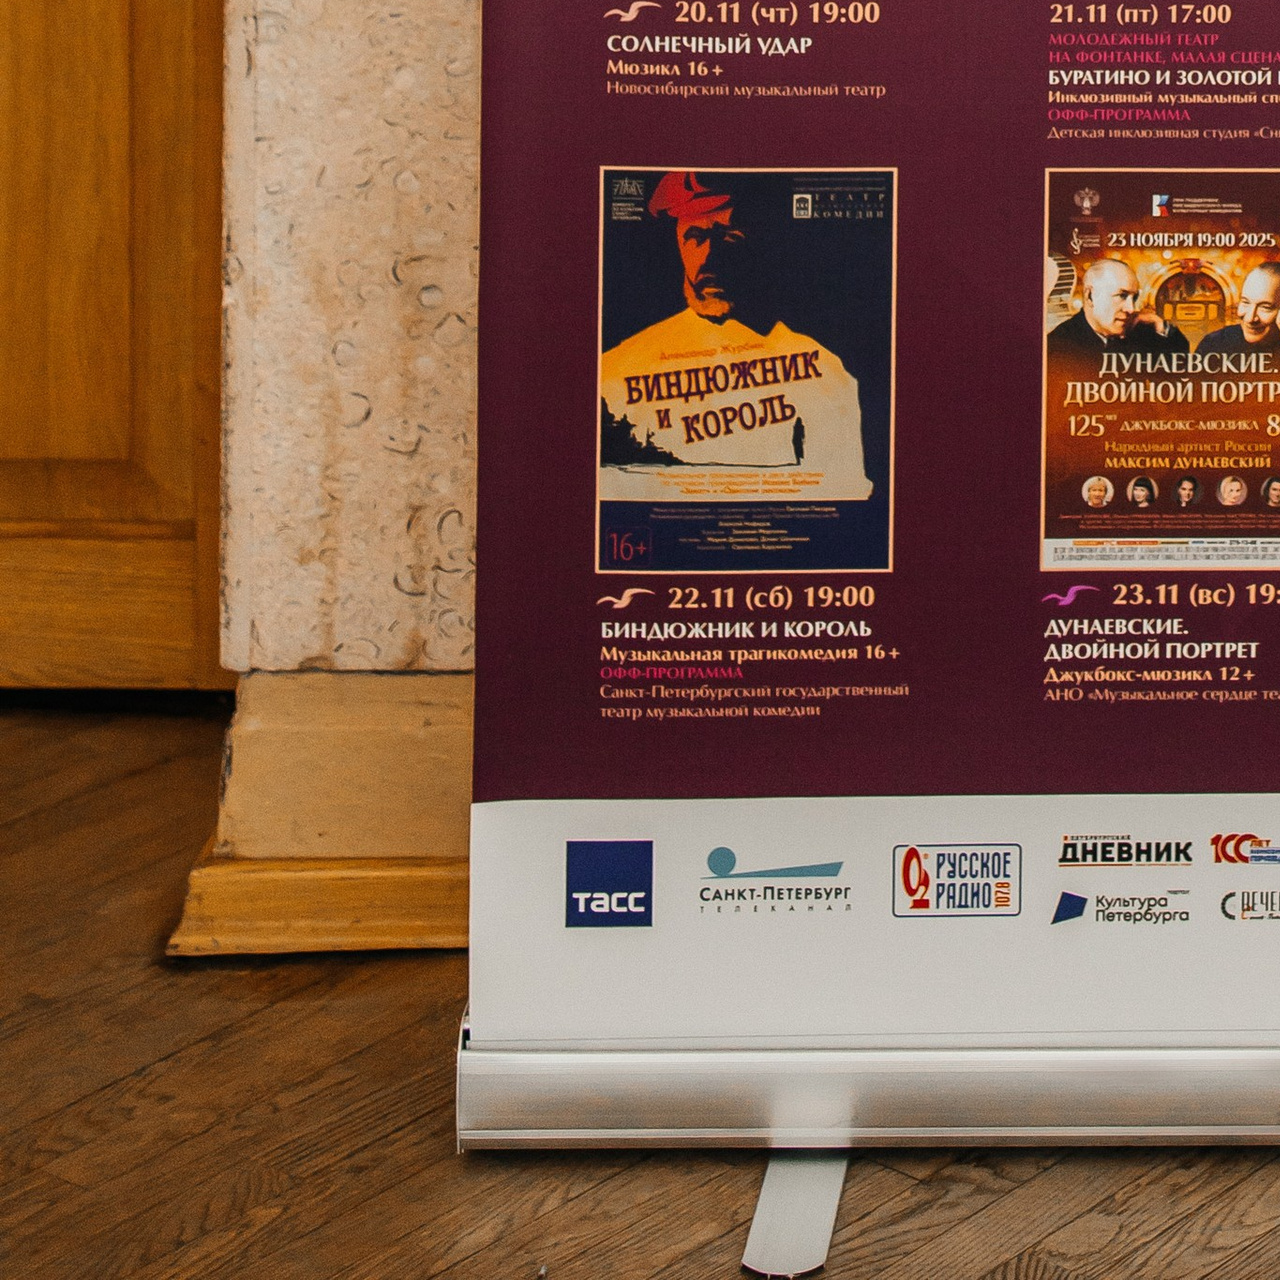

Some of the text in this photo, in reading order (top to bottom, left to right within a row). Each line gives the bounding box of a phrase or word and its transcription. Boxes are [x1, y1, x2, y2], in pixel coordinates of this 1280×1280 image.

[676, 1, 880, 25] 20.11 (чт) 19:00
[1051, 4, 1231, 25] 21.11 (пт) 17:00
[607, 33, 812, 56] СОЛНЕЧНЫЙ УДАР
[607, 60, 680, 75] Мюзикл
[1049, 70, 1150, 85] БУРАТИНО
[1156, 70, 1170, 85] И
[1176, 68, 1271, 85] ЗОЛОТОЙ
[607, 81, 886, 99] Новосибирский музыкальный театр
[1099, 352, 1279, 375] ДУНАЕВСКИЕ.
[1064, 378, 1194, 406] ДВОЙНОЙ
[668, 585, 874, 610] 22.11 (сб) 19:00
[1113, 584, 1178, 605] 23.11
[1190, 584, 1235, 607] (вс)
[602, 621, 872, 641] БИНДЮЖНИК И КОРОЛЬ
[1044, 619, 1188, 638] ДУНАЕВСКИЕ.
[1044, 639, 1259, 662] ДВОЙНОЙ ПОРТРЕТ
[1059, 842, 1192, 863] ДНЕВНИК
[936, 852, 1011, 879] РУССКОЕ
[936, 883, 995, 909] РАДИО
[1096, 893, 1172, 912] Культура
[1096, 907, 1189, 924] Петербурга
